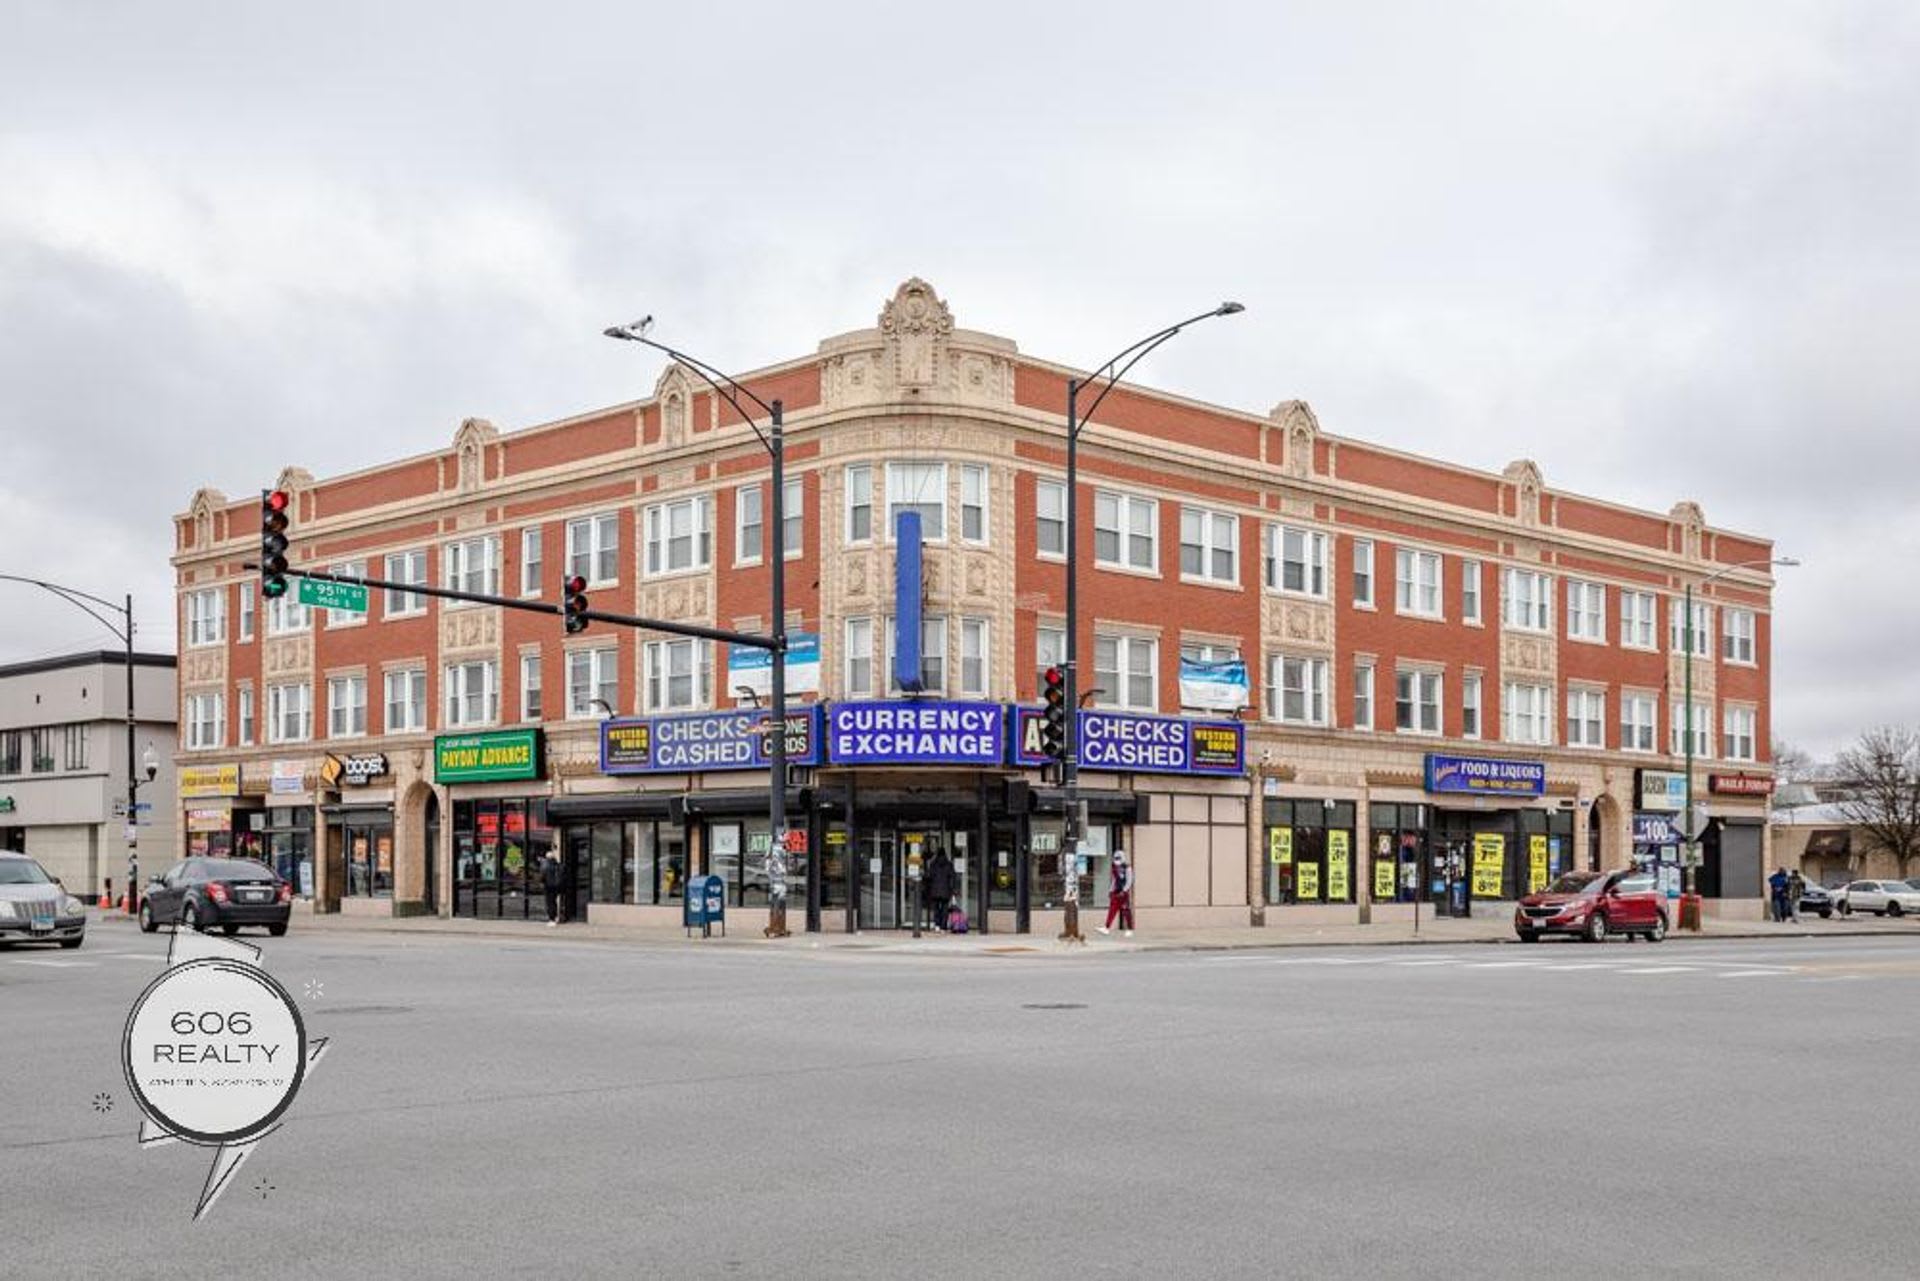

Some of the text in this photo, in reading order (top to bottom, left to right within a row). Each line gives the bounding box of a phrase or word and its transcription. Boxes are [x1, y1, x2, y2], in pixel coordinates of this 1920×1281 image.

[656, 717, 750, 742] CHECKS
[838, 709, 995, 731] CURRENCY
[1085, 717, 1184, 744] CHECKS
[763, 736, 808, 754] CRDS
[838, 734, 994, 755] EXCHANGE
[1194, 730, 1236, 741] WESTERN
[482, 745, 529, 766] ADVANCE
[656, 741, 751, 765] CASHED
[1085, 741, 1184, 766] CASHED
[345, 756, 384, 775] boost
[1461, 762, 1489, 776] FOOD
[1500, 765, 1542, 779] LIQUORS
